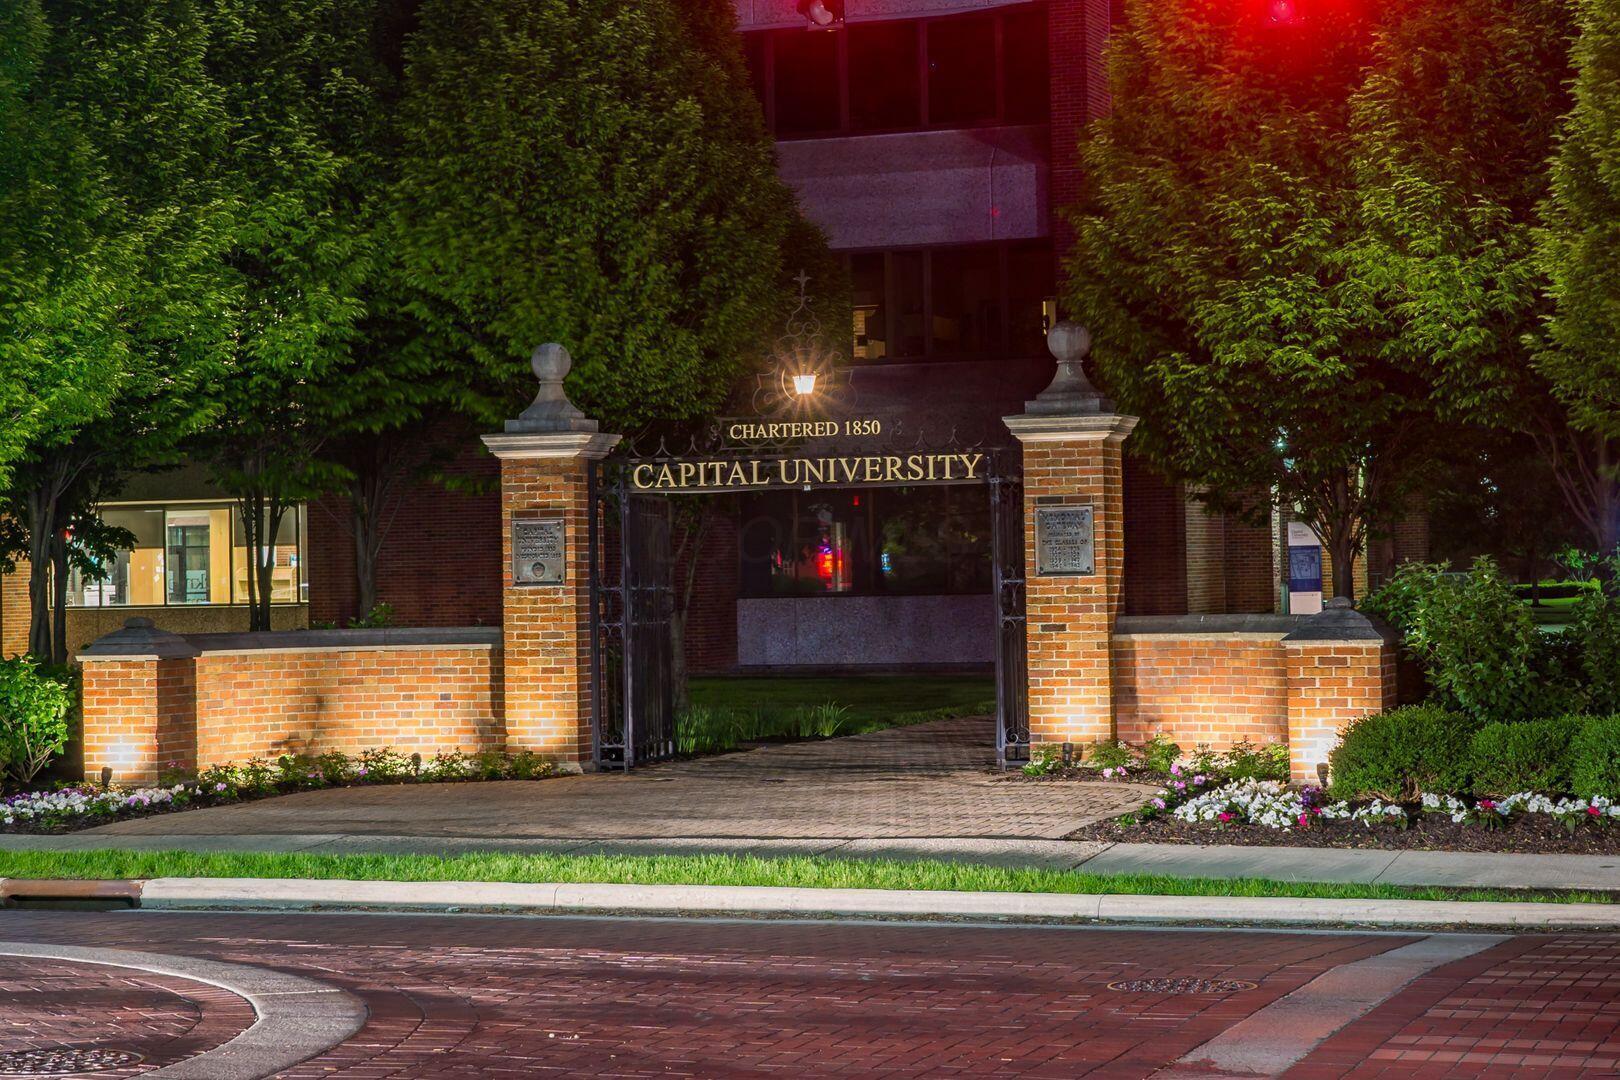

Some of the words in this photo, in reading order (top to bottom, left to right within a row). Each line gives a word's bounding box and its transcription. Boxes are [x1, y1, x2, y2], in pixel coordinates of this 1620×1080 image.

[729, 422, 839, 440] CHARTERED
[844, 420, 881, 437] 1850
[633, 461, 770, 490] CAPITAL
[778, 453, 984, 484] UNIVERSITY
